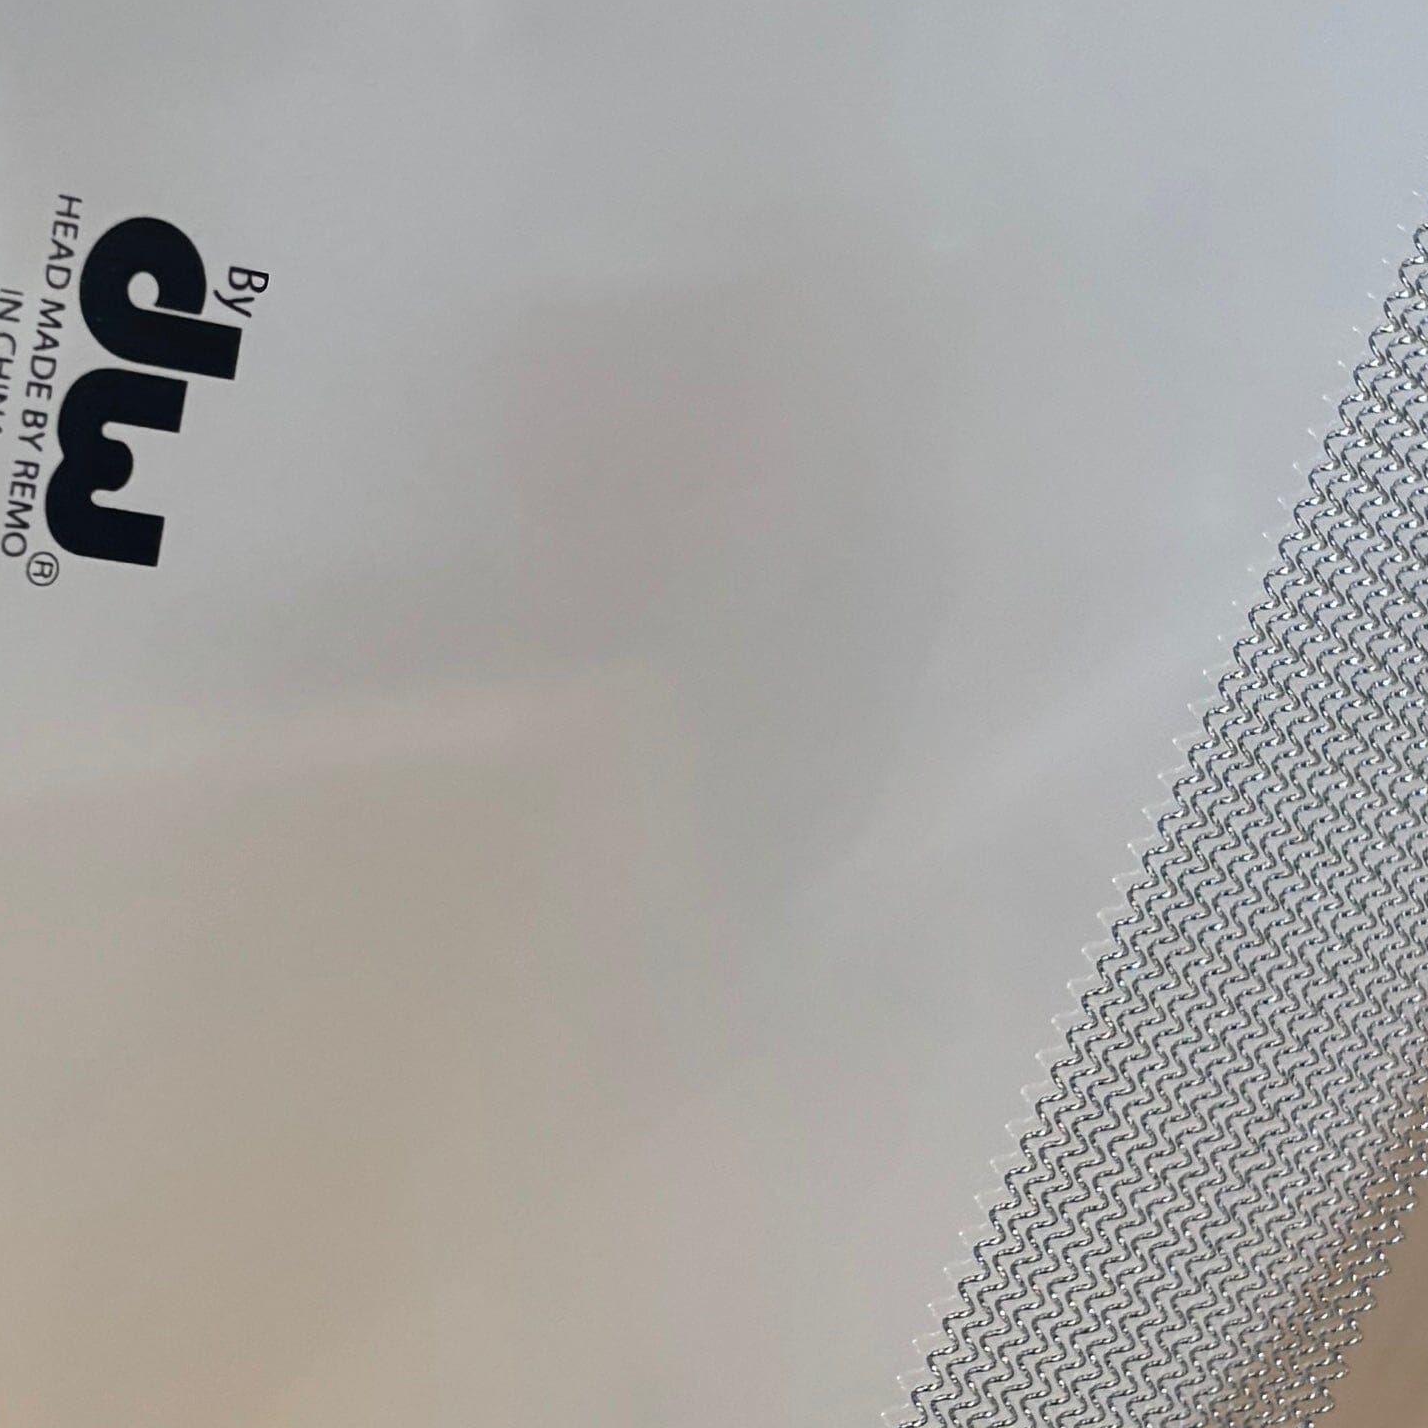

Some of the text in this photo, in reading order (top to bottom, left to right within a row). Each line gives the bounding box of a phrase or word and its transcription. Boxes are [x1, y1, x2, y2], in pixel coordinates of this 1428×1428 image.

[45, 194, 82, 290] HEAD
[212, 265, 271, 319] By
[25, 298, 67, 402] MADE
[18, 408, 49, 454] BY
